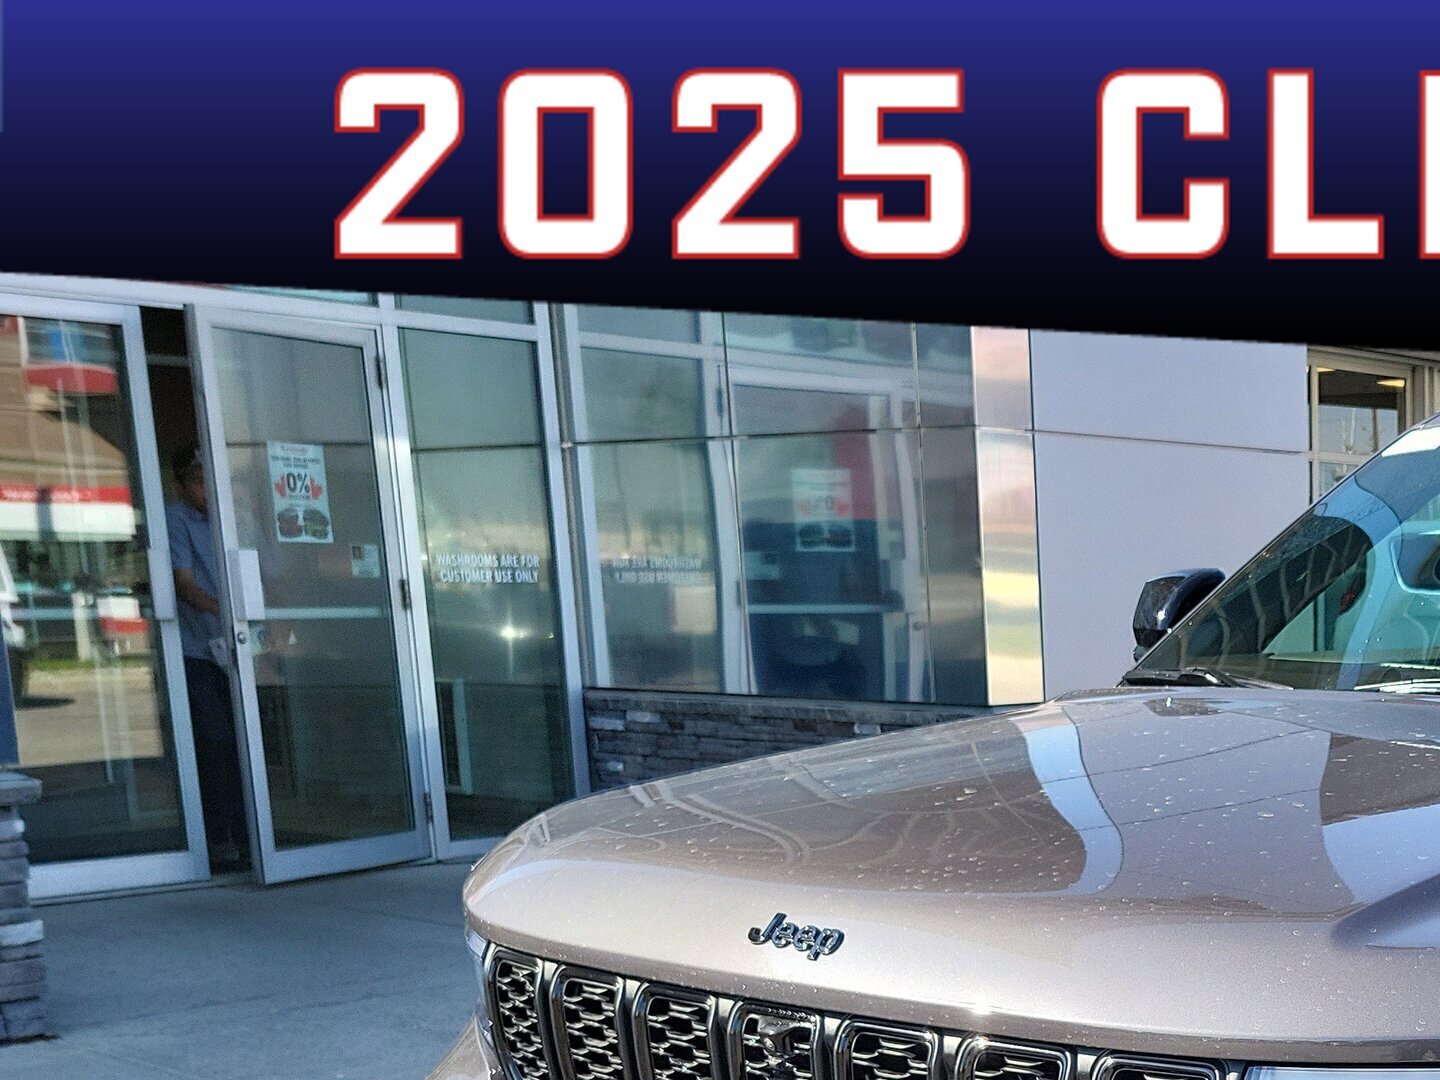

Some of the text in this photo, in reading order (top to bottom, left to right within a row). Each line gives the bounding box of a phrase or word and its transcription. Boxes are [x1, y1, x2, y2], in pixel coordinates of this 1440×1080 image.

[286, 472, 310, 493] 0%
[436, 553, 540, 568] WASHROOMS ARE FOR
[441, 568, 539, 583] CUSTOMER USE ONLY
[748, 912, 845, 961] Jeep
